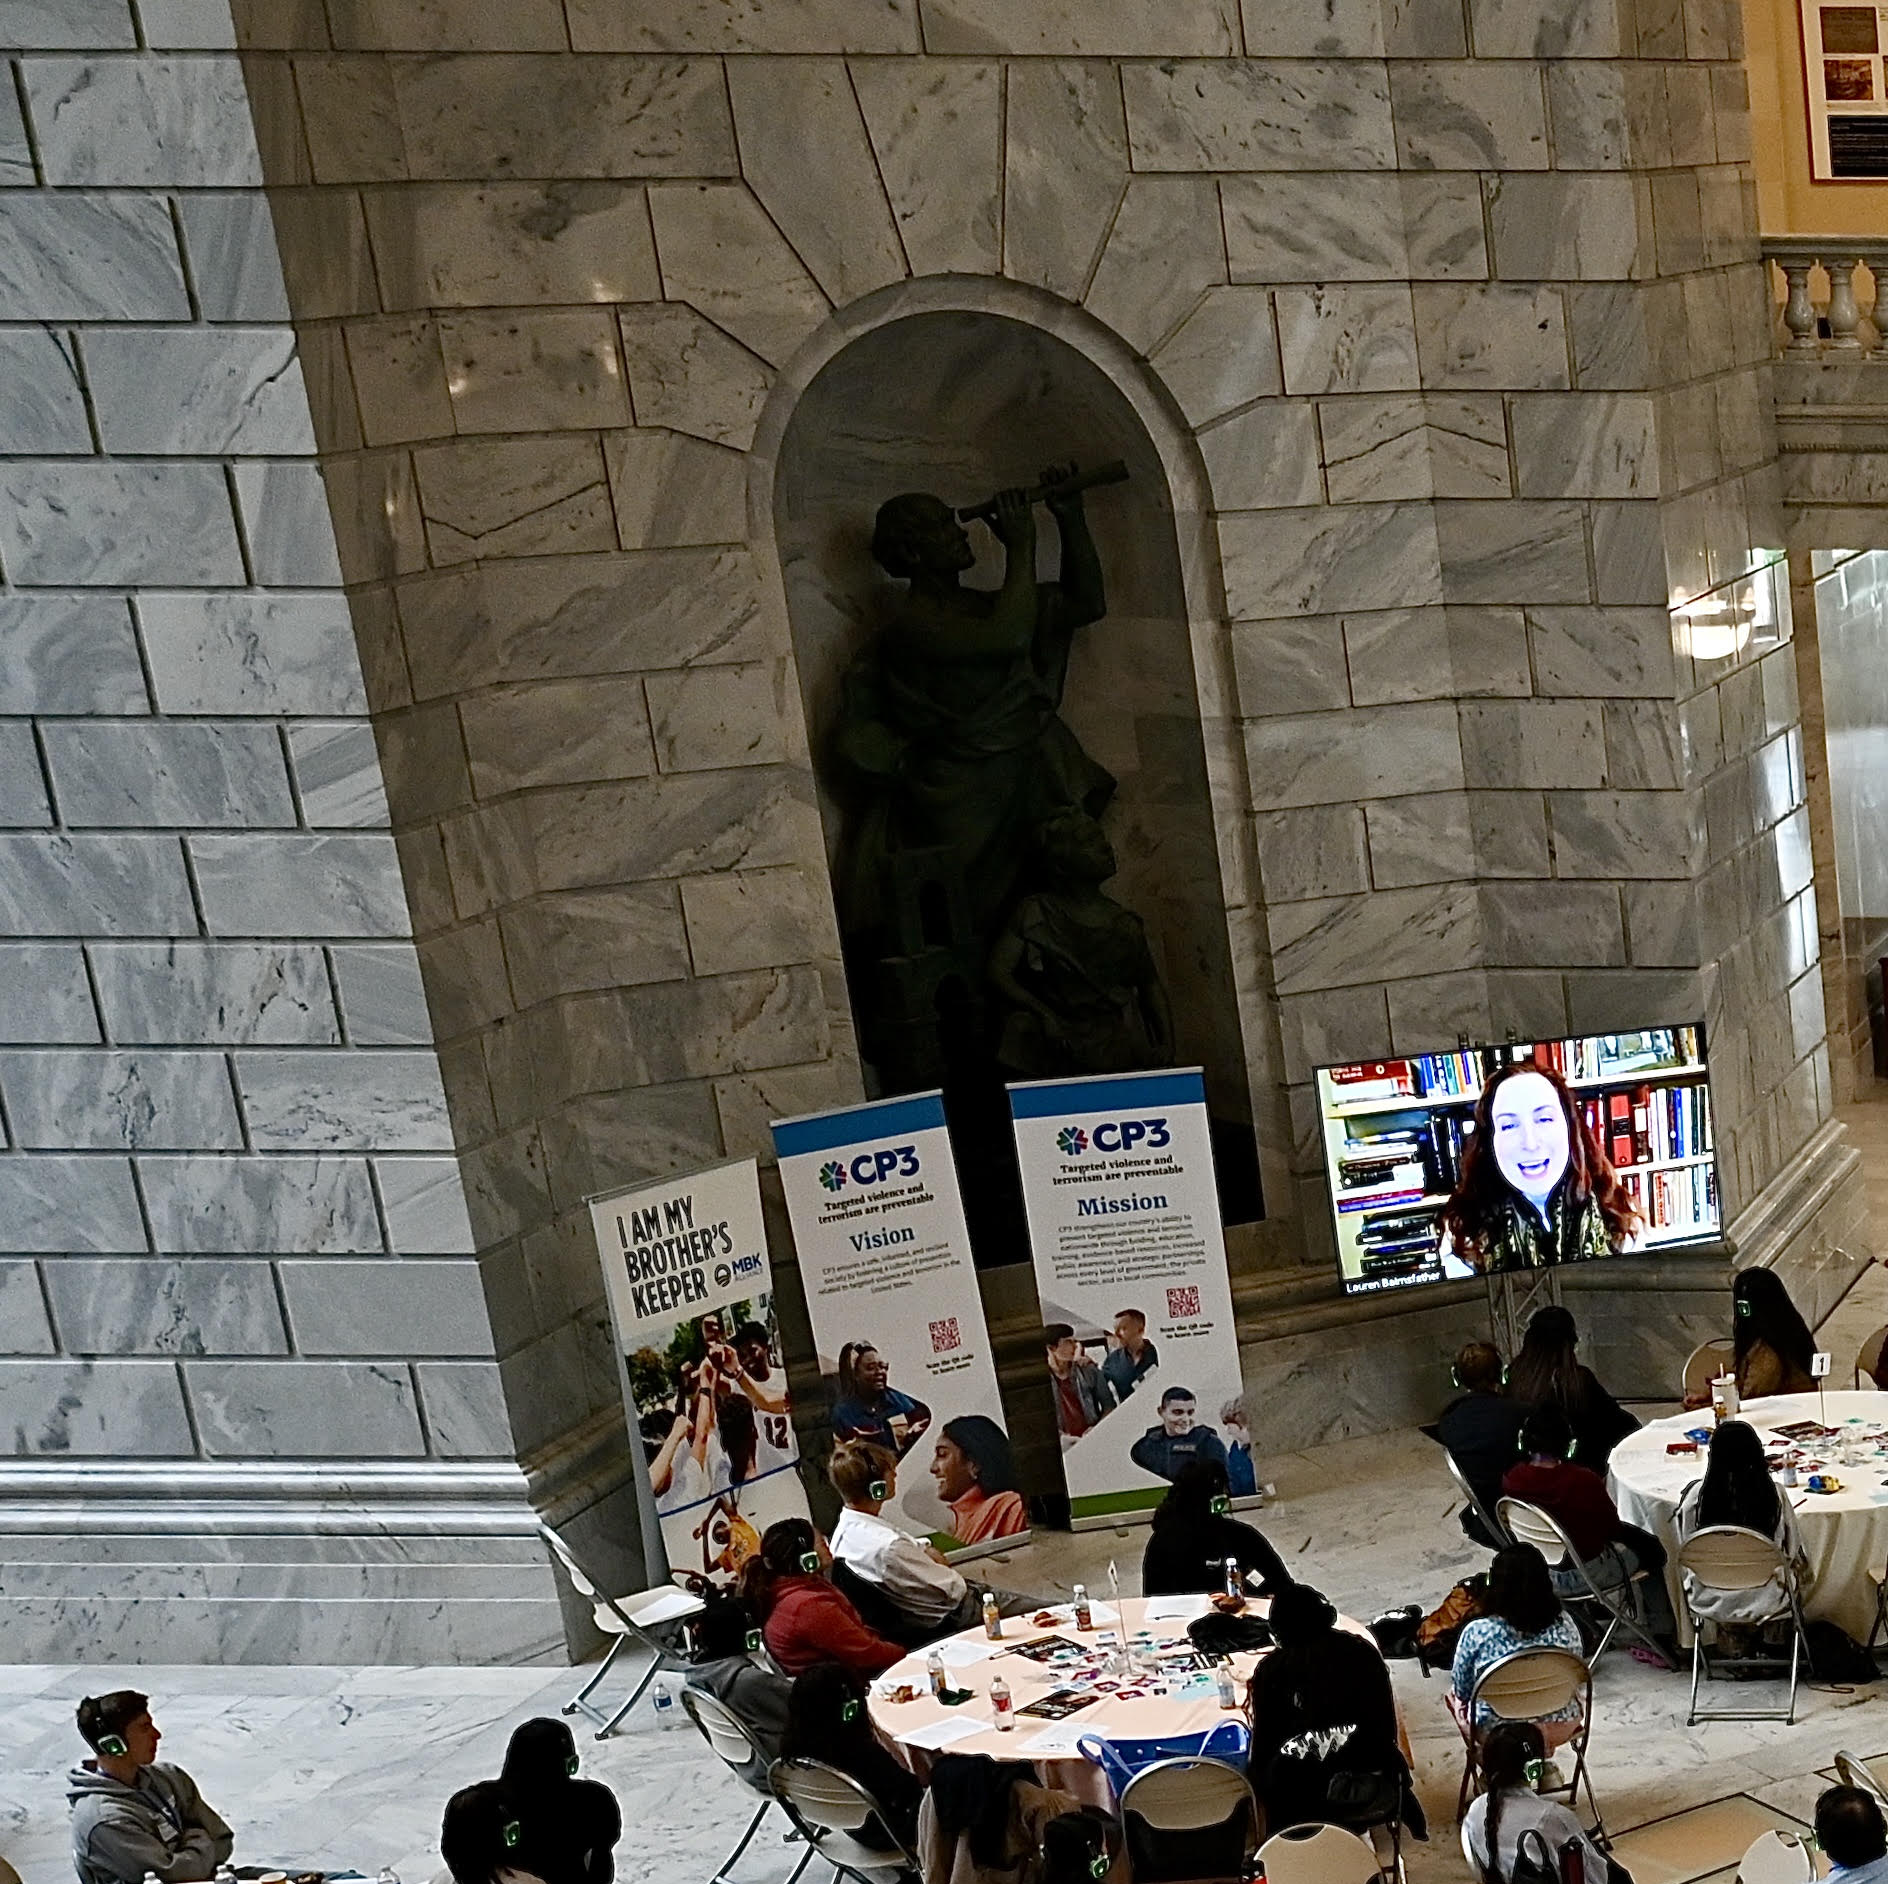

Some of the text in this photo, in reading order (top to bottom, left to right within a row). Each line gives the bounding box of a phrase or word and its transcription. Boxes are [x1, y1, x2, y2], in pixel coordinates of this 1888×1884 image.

[1093, 1118, 1170, 1152] CP3
[850, 1145, 920, 1185] CP3
[1053, 1165, 1184, 1185] terrorism are preventable
[1060, 1155, 1173, 1174] Targeted violence and
[818, 1193, 934, 1224] terrorism are preventable
[825, 1182, 924, 1212] Targeted violence and
[1078, 1193, 1168, 1216] Mission
[617, 1195, 694, 1248] I AM MY
[624, 1221, 732, 1284] BROTHER'S
[849, 1227, 915, 1252] Vision
[732, 1252, 762, 1275] MBK
[631, 1267, 708, 1319] KEEPER
[1346, 1276, 1381, 1294] Lauren
[1819, 1357, 1825, 1372] 1
[764, 1417, 788, 1448] 12
